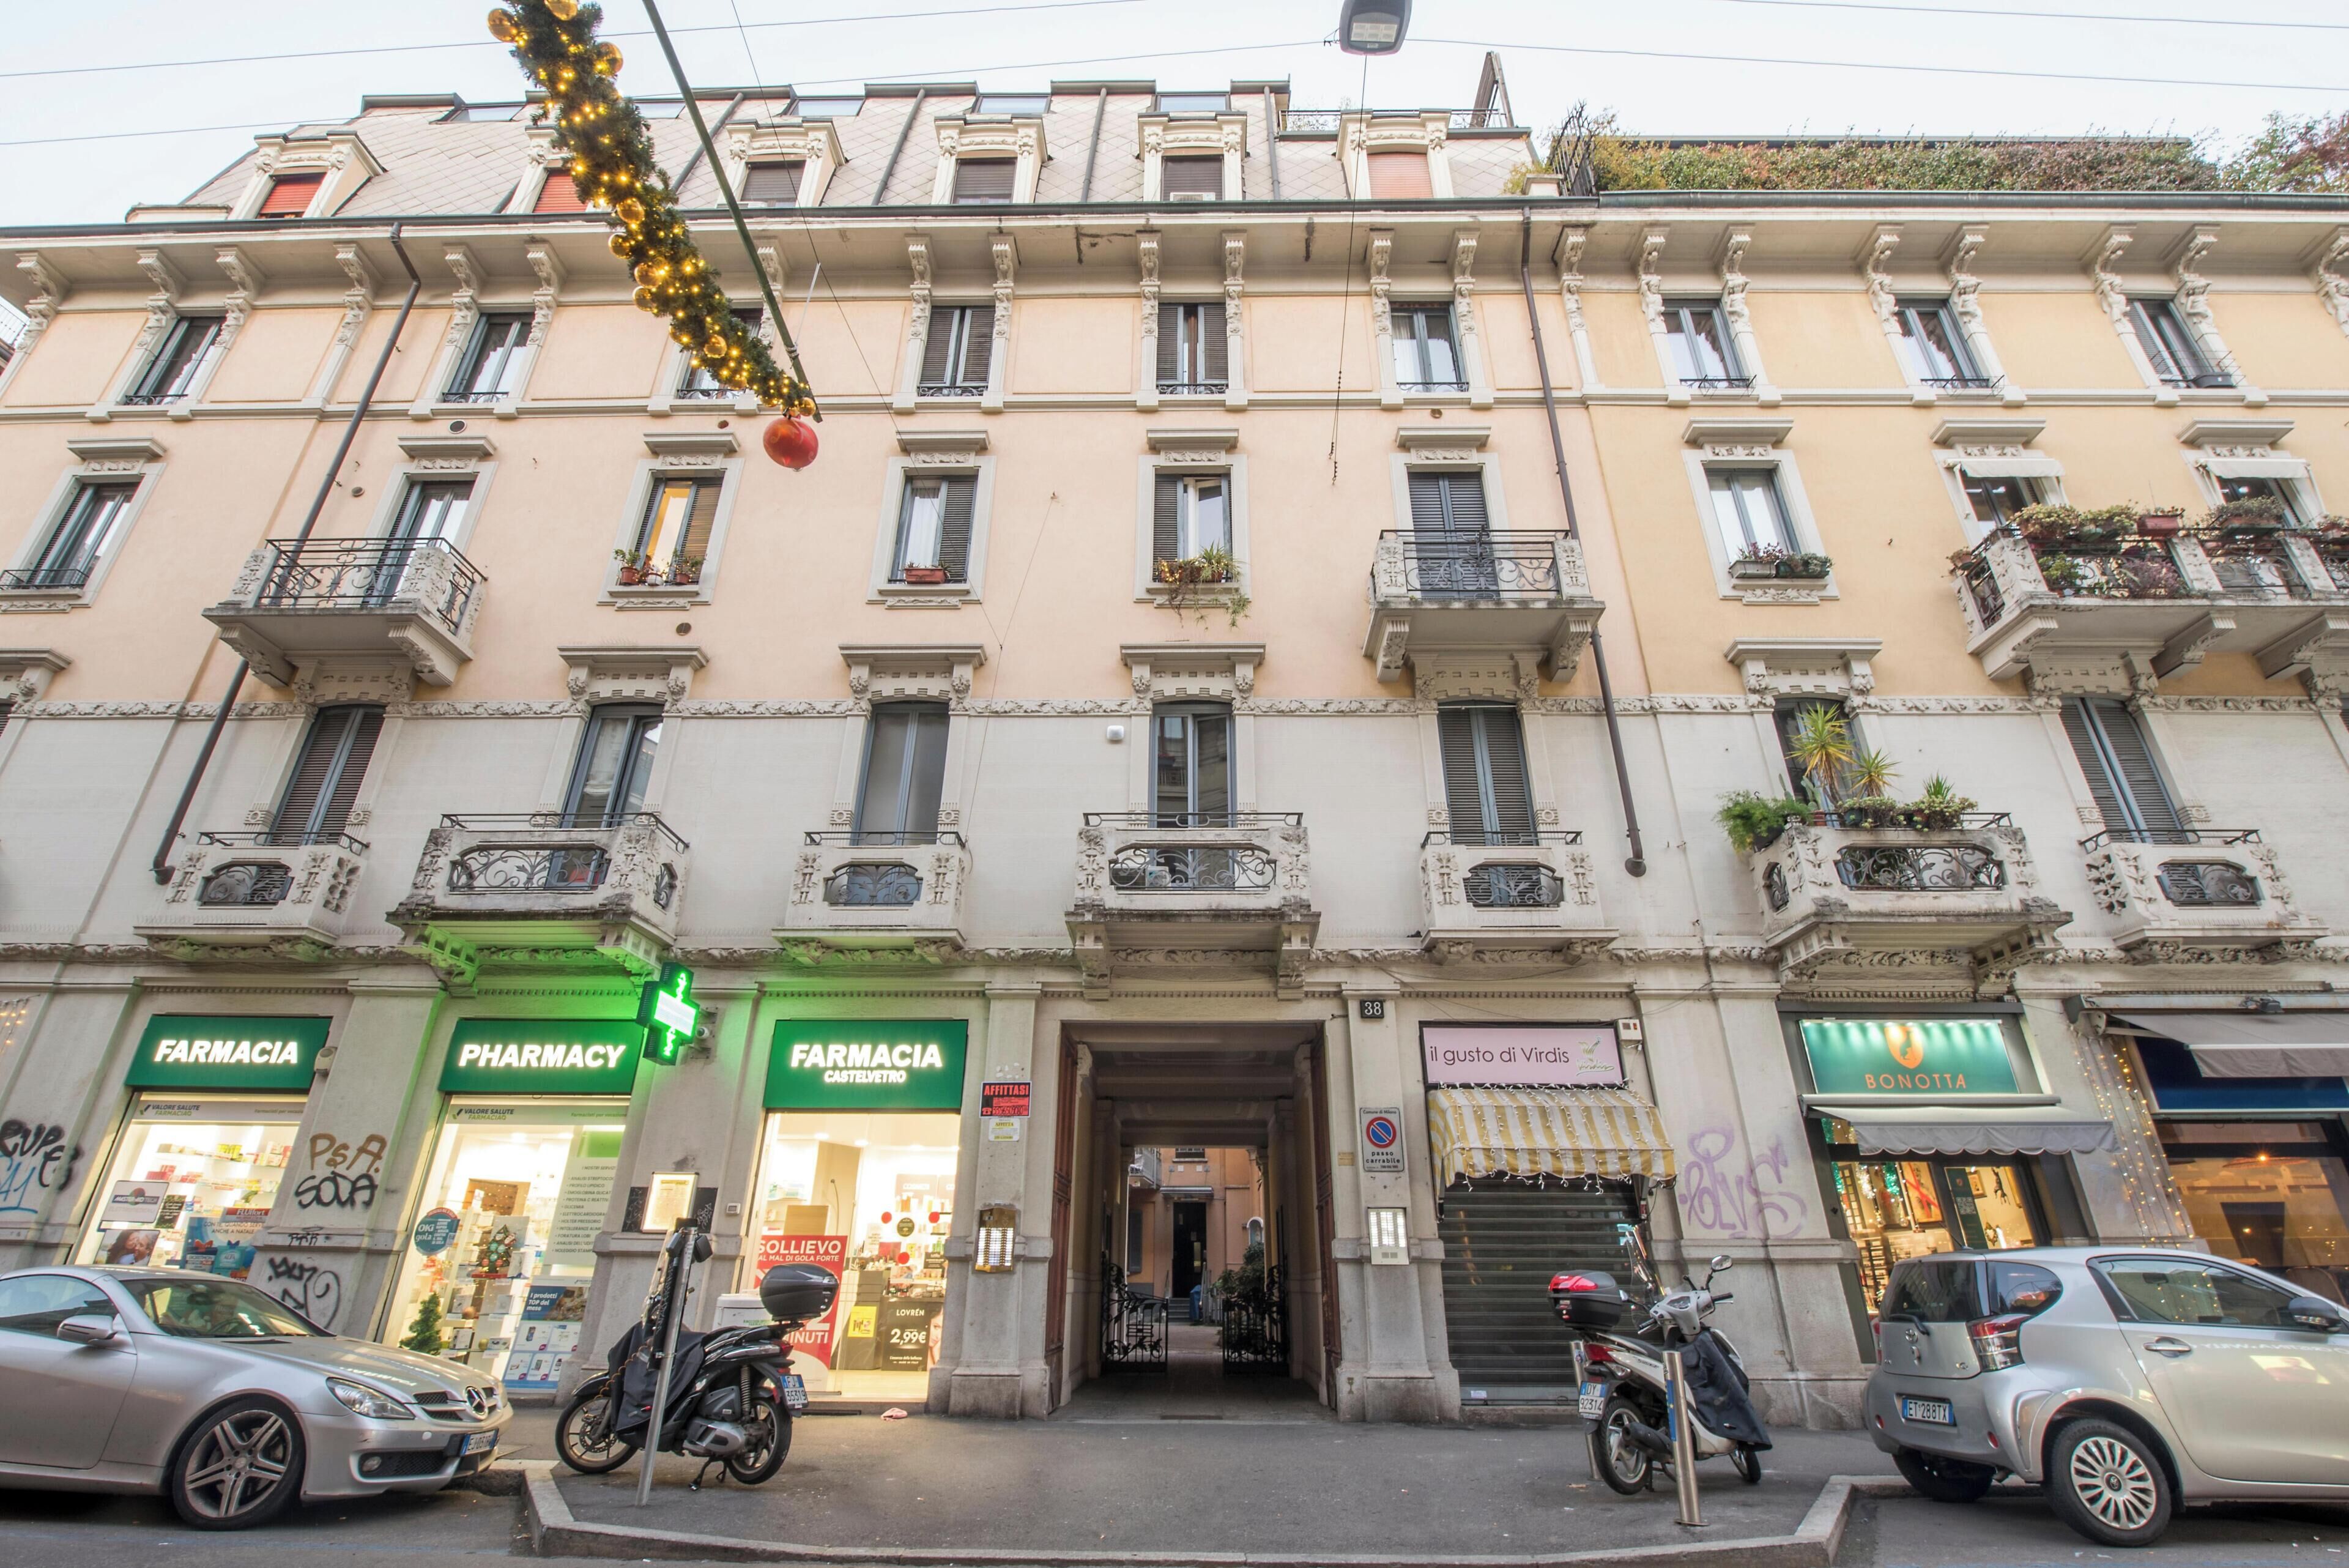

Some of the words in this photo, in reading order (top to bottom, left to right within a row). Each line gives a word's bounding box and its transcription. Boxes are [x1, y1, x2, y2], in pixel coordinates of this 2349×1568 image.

[1365, 1001, 1382, 1015] 38
[154, 1039, 298, 1064] FARMACIA
[459, 1044, 626, 1068] PHARMACY
[791, 1044, 943, 1068] FARMACIA
[1430, 1046, 1438, 1061] il
[1443, 1047, 1494, 1066] gusto
[1500, 1047, 1517, 1063] di
[1521, 1047, 1570, 1063] Virdis
[825, 1070, 907, 1083] CASTELVETRO
[1865, 1073, 1966, 1089] BONOTTA
[984, 1085, 1029, 1096] AFFITTASI
[416, 1233, 432, 1242] gola
[759, 1239, 842, 1254] SOLLIEVO
[889, 1328, 927, 1345] 2,99€
[786, 1390, 807, 1402] 35319
[1586, 1384, 1597, 1395] DY
[1580, 1397, 1603, 1412] 92314
